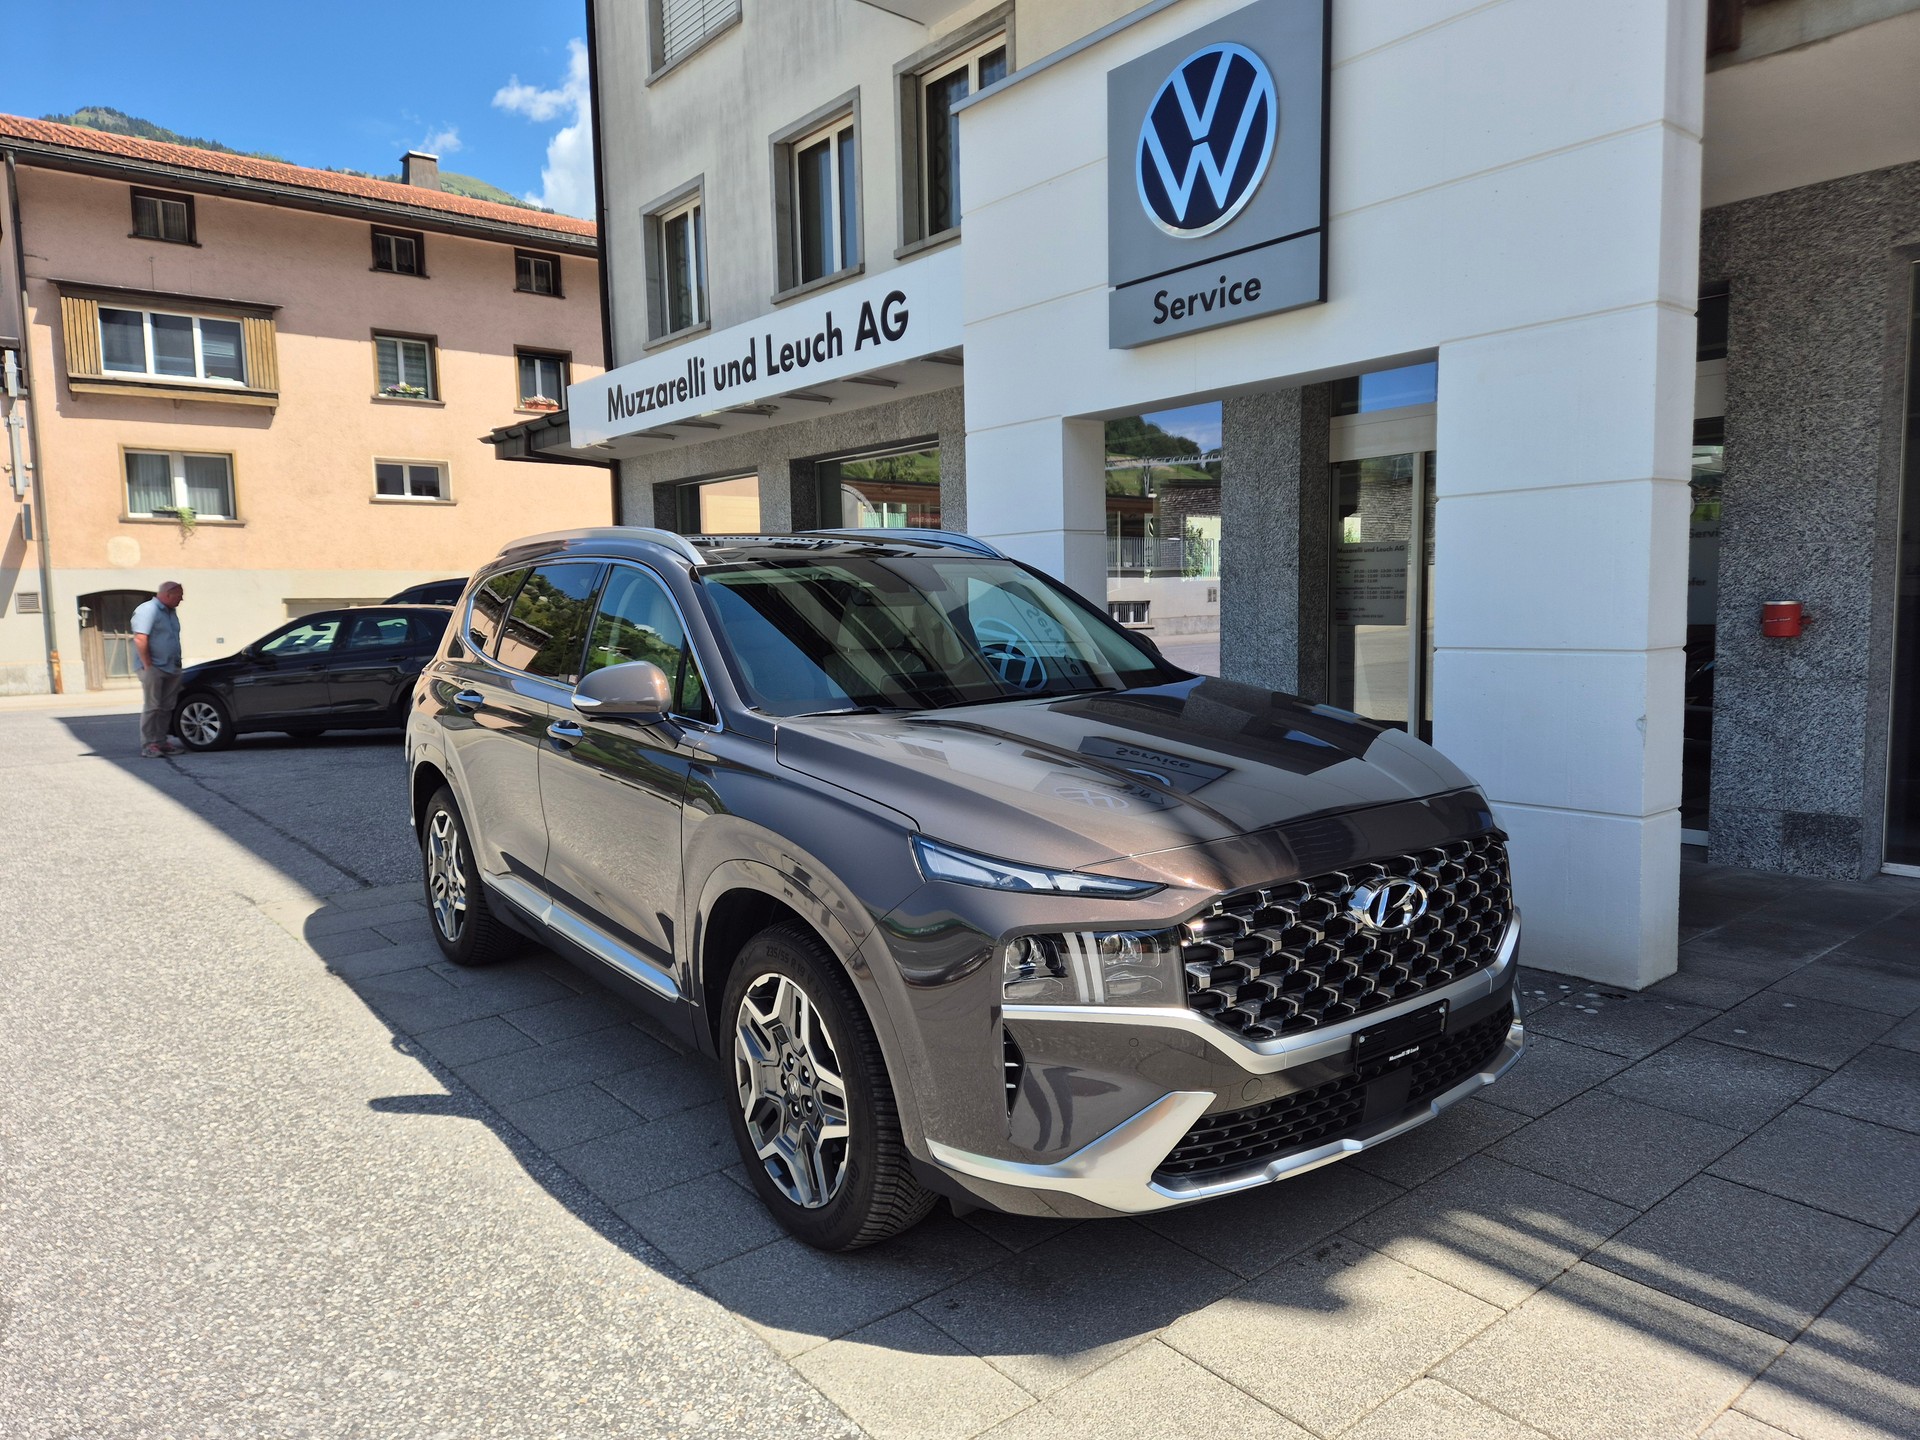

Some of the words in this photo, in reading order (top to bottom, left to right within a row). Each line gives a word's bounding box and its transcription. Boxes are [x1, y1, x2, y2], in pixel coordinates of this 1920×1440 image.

[1153, 275, 1262, 325] Service
[607, 356, 706, 423] Muzzarelli
[713, 337, 757, 392] und
[766, 311, 843, 377] Leuch
[854, 290, 909, 352] AG
[766, 945, 790, 964] 235/55
